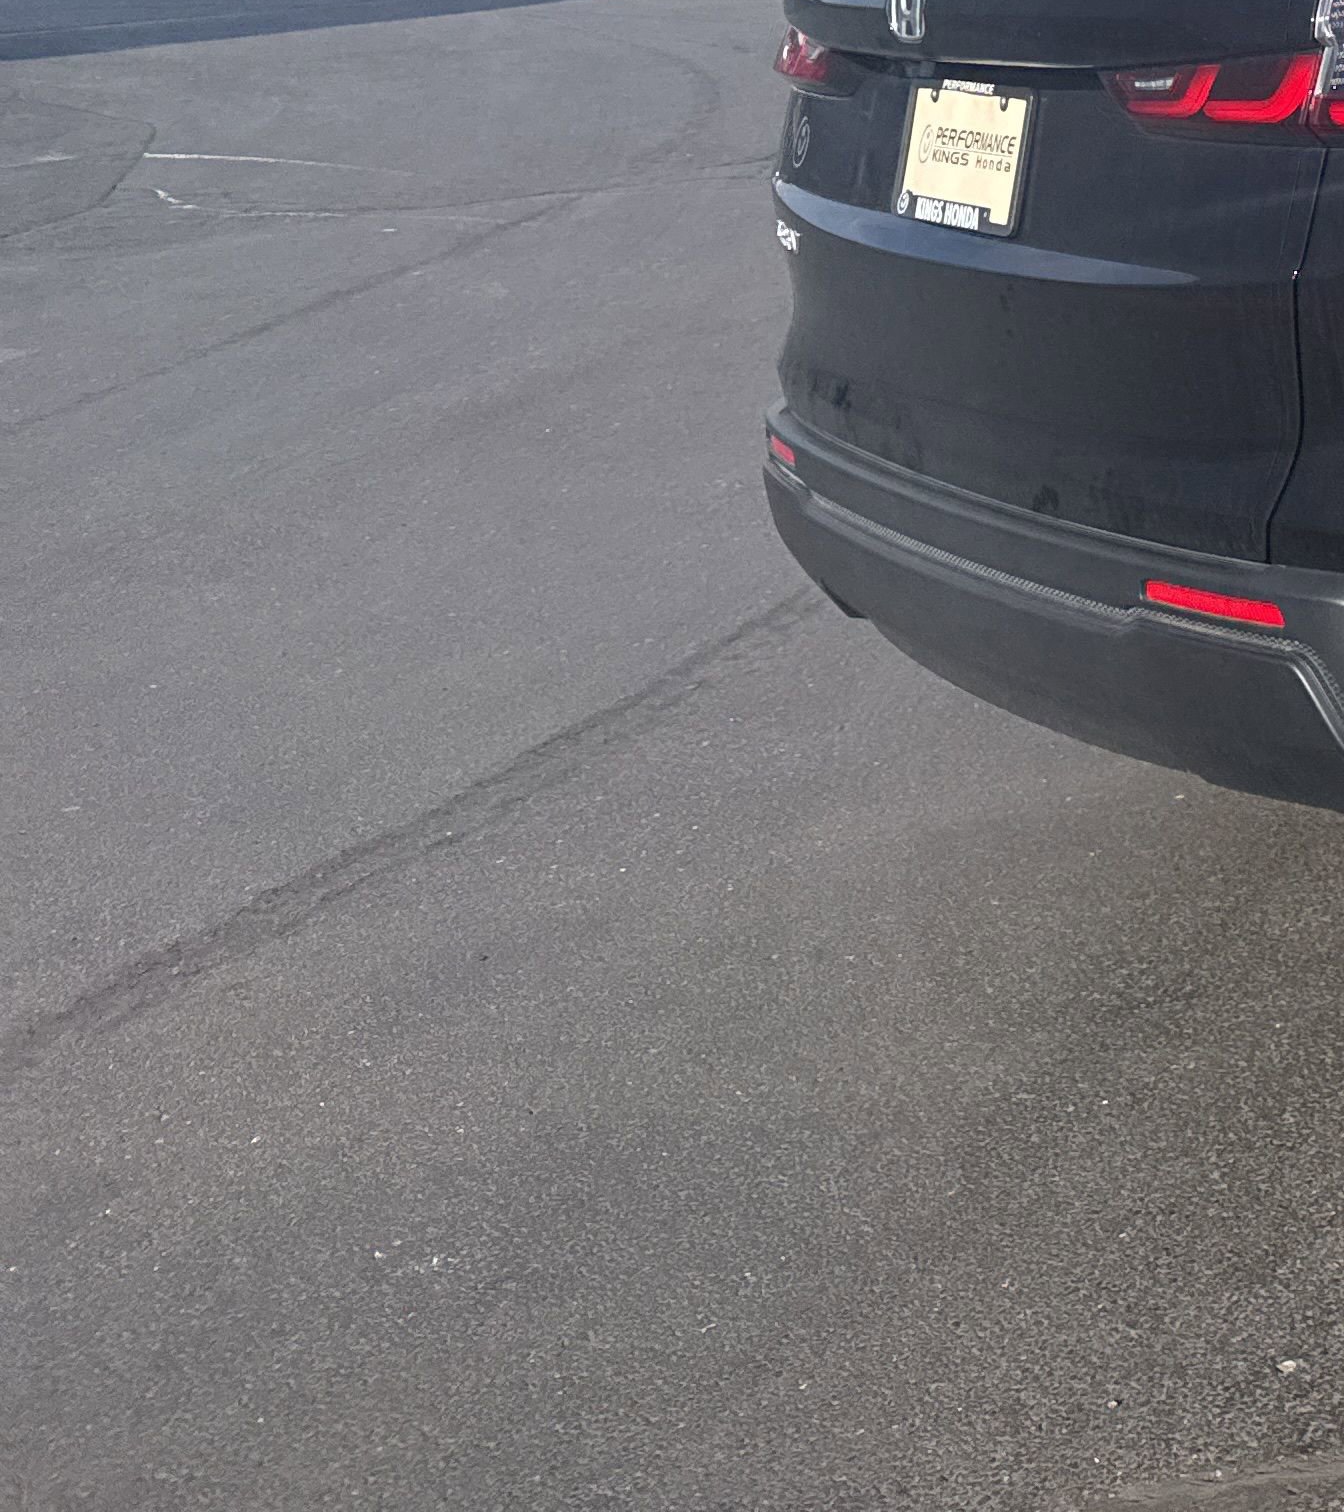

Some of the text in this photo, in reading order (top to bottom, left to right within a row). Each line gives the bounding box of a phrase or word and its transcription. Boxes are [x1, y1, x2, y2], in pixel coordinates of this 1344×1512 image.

[941, 79, 996, 96] PERFORMANCE
[934, 126, 1017, 155] PERFORMANCE
[932, 149, 1011, 173] KINGS Honda
[915, 197, 980, 230] KINGS HONDA
